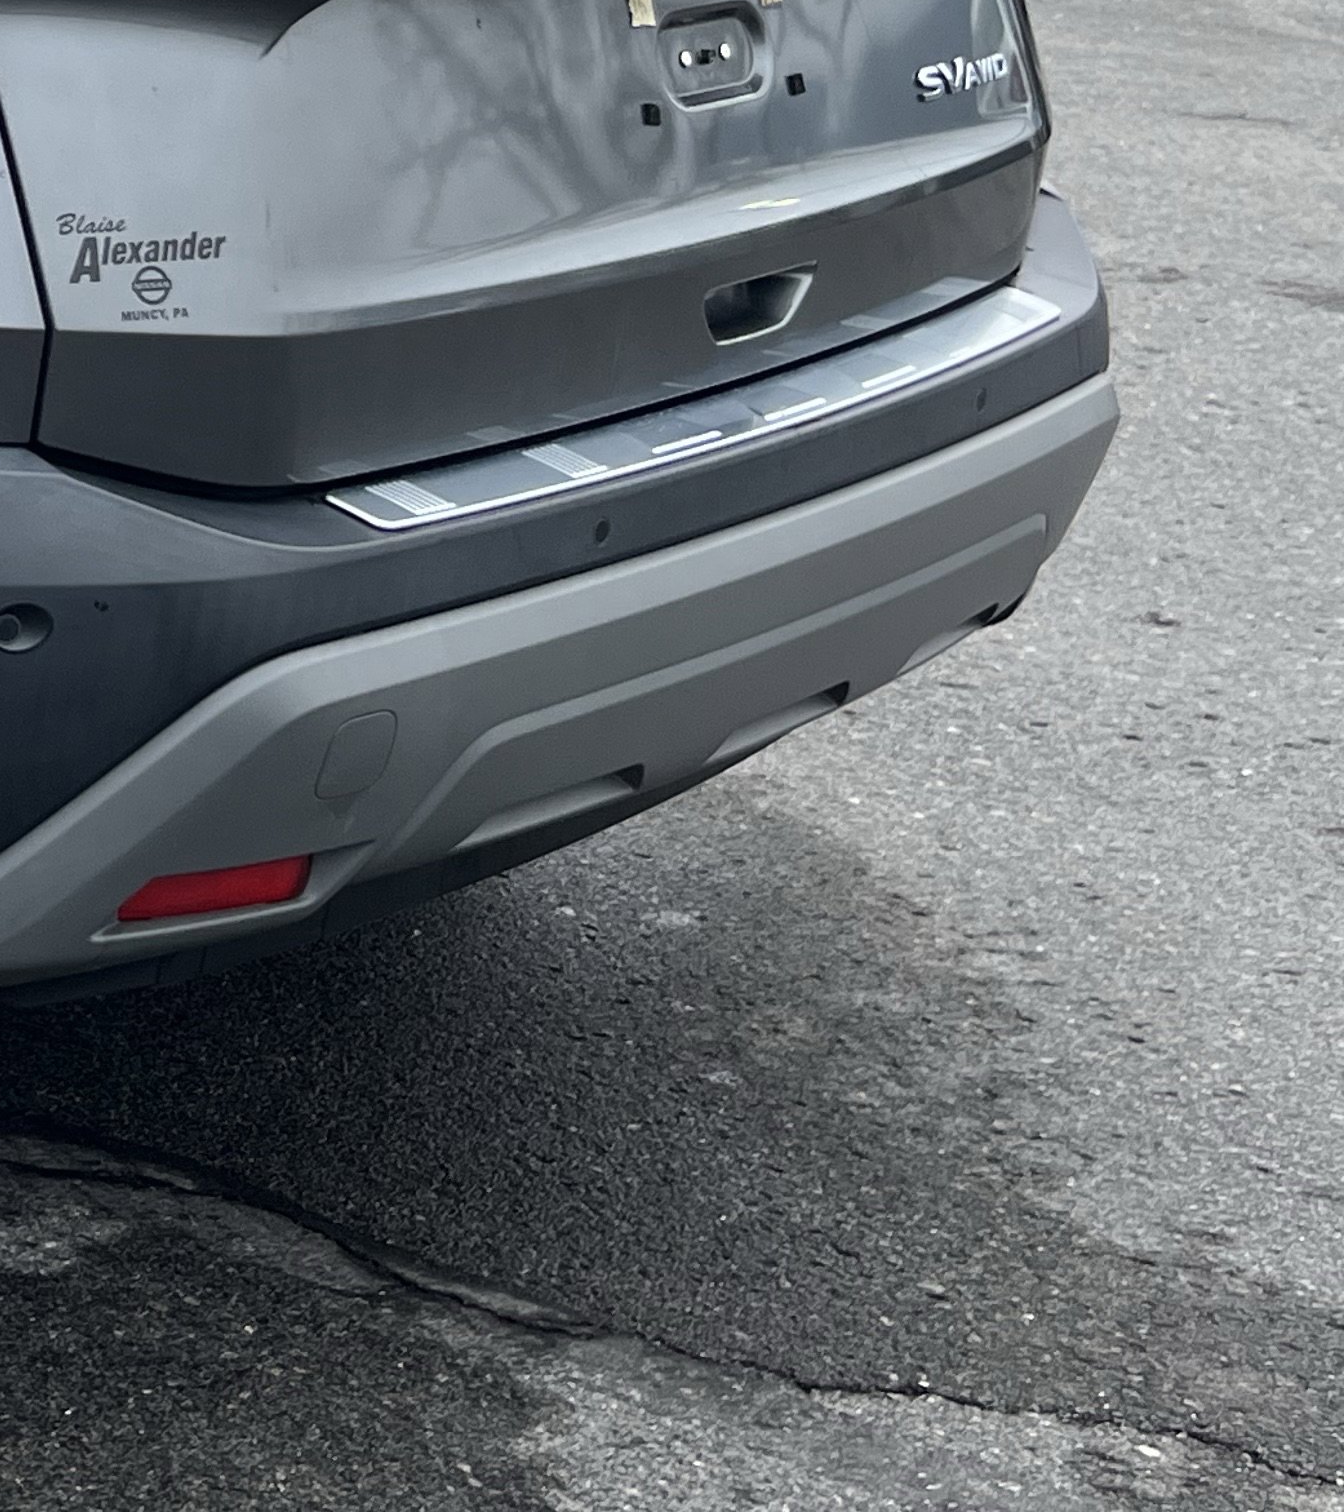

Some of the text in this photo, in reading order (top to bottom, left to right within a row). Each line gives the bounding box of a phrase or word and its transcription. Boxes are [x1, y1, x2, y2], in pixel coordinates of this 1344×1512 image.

[56, 212, 127, 236] Blaise
[69, 231, 227, 284] Alexander
[173, 307, 189, 319] PA
